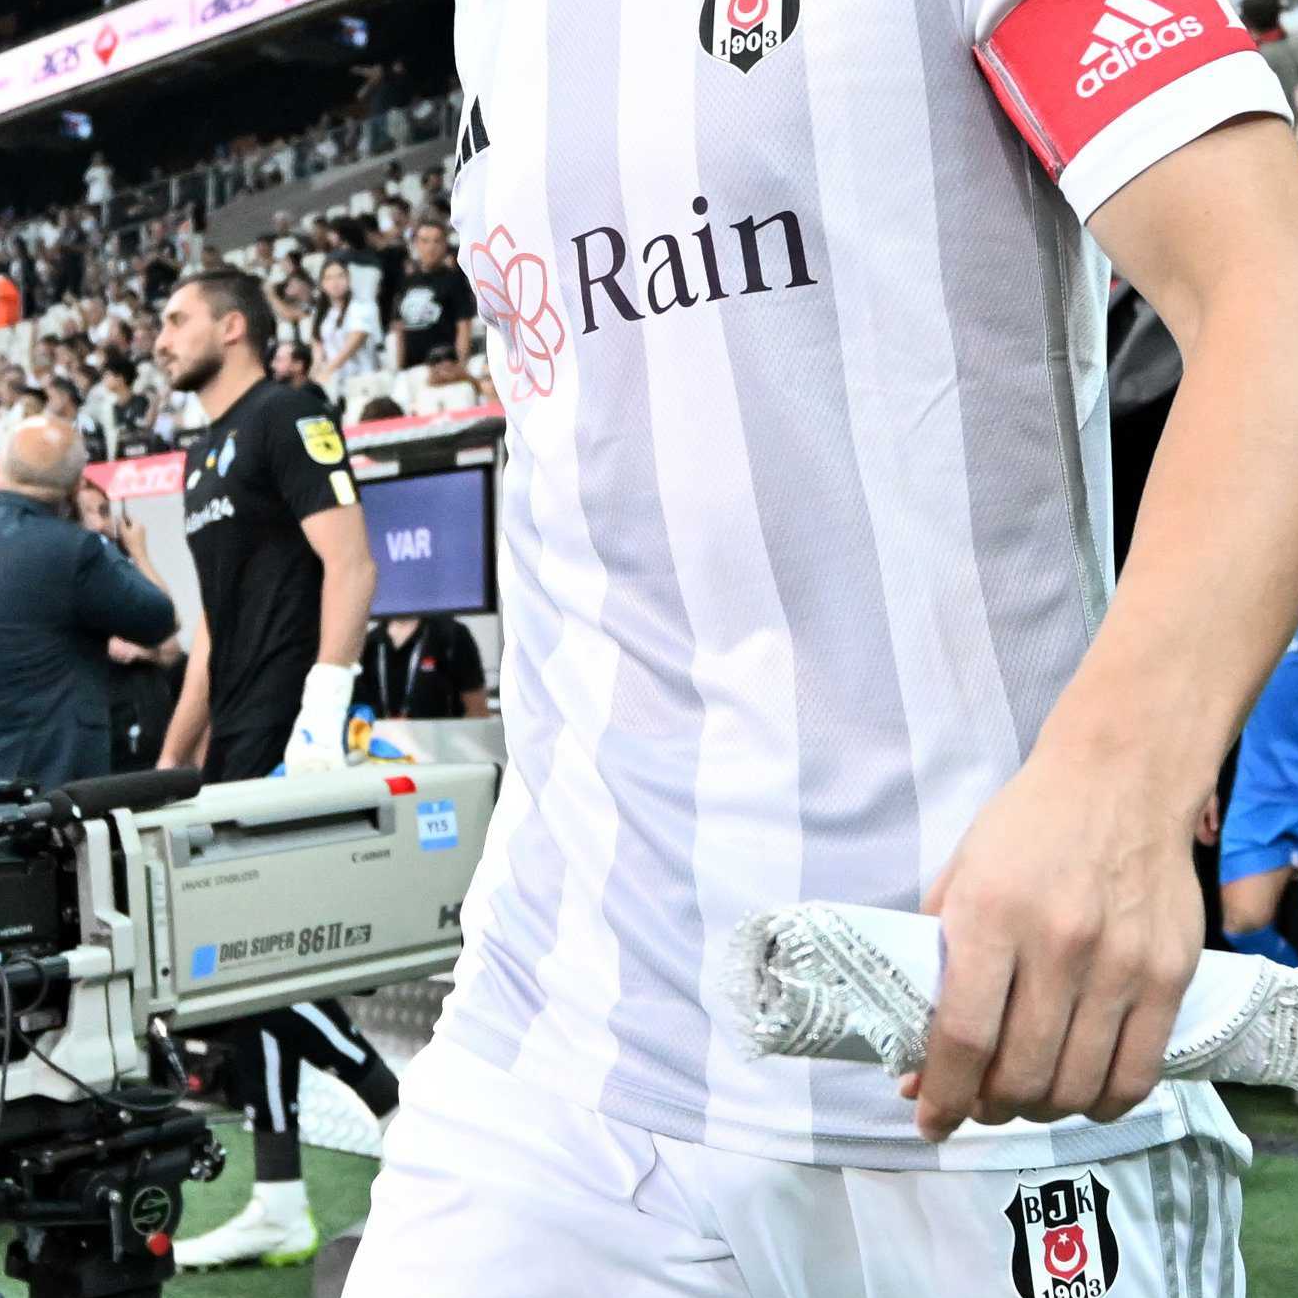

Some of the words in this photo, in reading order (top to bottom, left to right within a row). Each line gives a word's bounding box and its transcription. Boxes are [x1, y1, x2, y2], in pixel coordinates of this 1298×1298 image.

[719, 30, 777, 56] 1903
[1076, 15, 1204, 98] adidas
[572, 195, 819, 336] Rain
[386, 527, 432, 562] VAR
[438, 902, 462, 930] H
[219, 940, 249, 963] DIGI
[251, 930, 295, 956] SUPER
[1023, 1183, 1095, 1226] BJK
